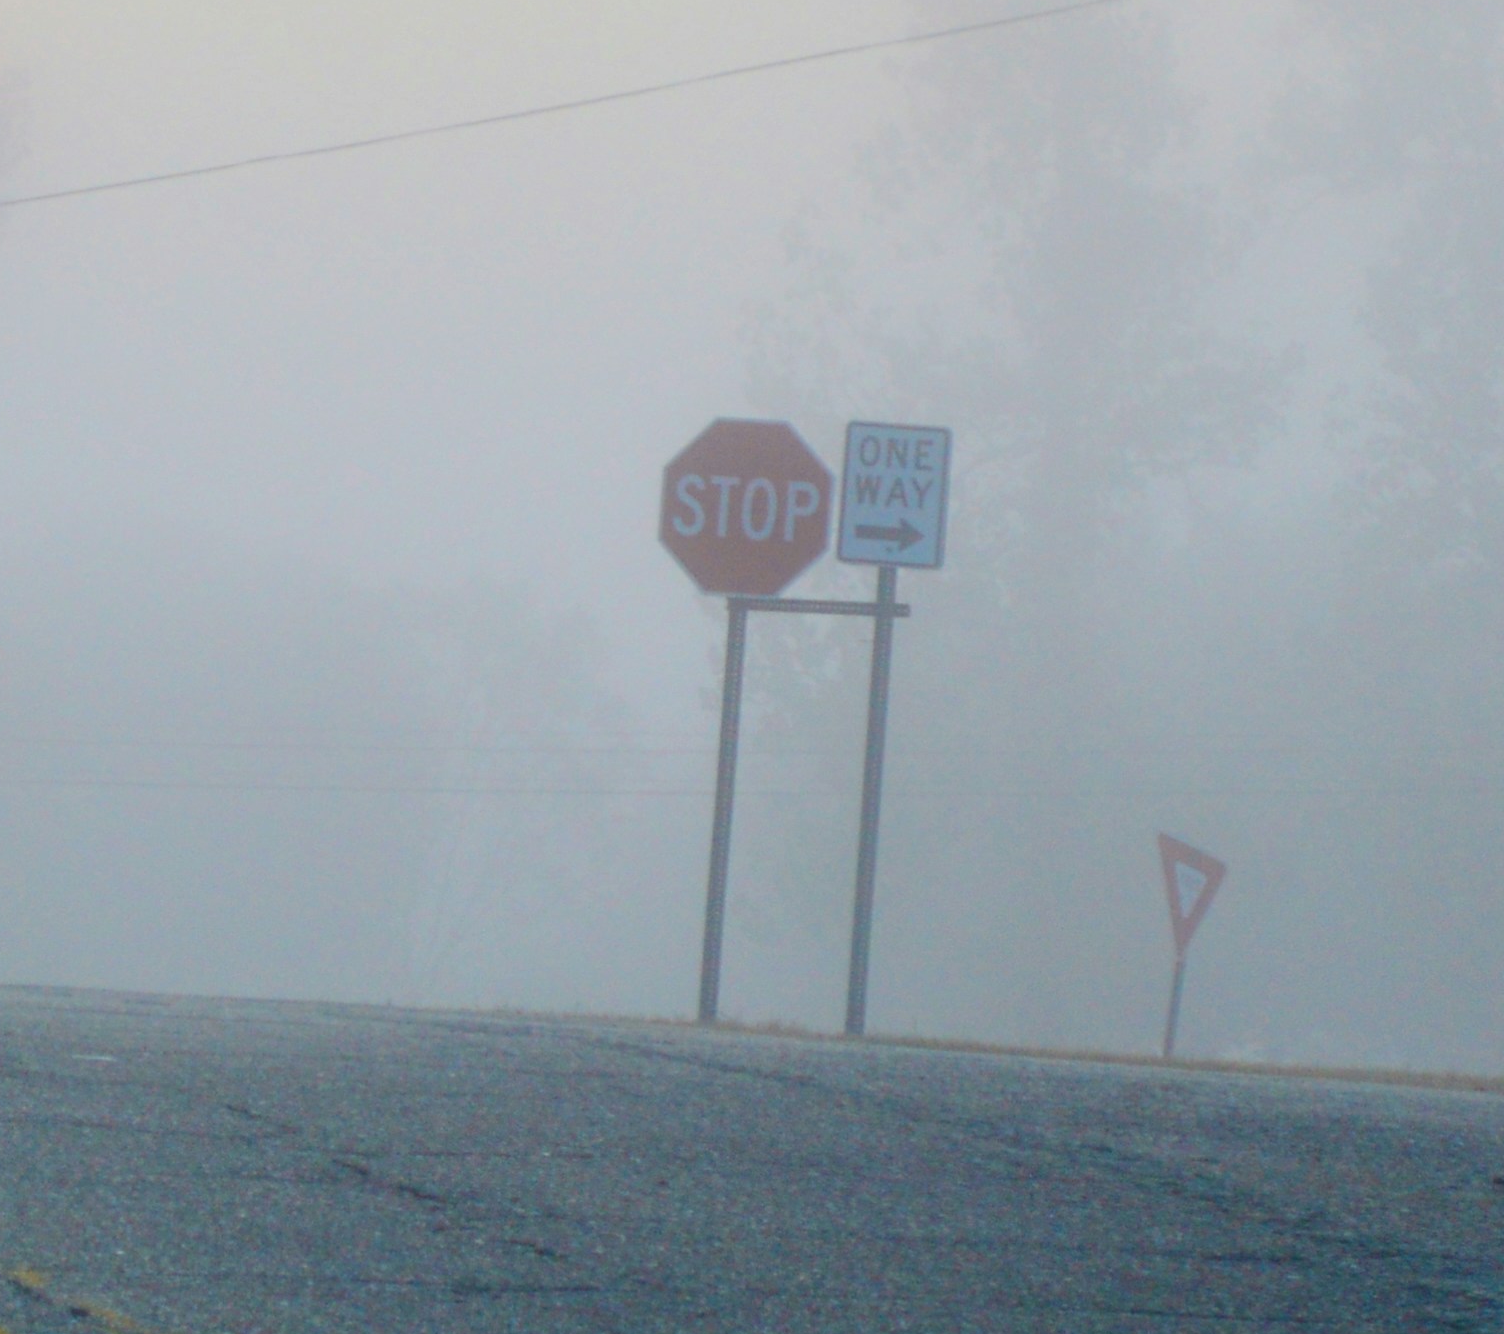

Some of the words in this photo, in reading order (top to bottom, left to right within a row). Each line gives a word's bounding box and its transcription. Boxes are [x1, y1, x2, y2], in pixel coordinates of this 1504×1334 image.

[859, 436, 934, 471] ONE
[671, 473, 820, 542] STOP
[854, 472, 933, 510] WAY
